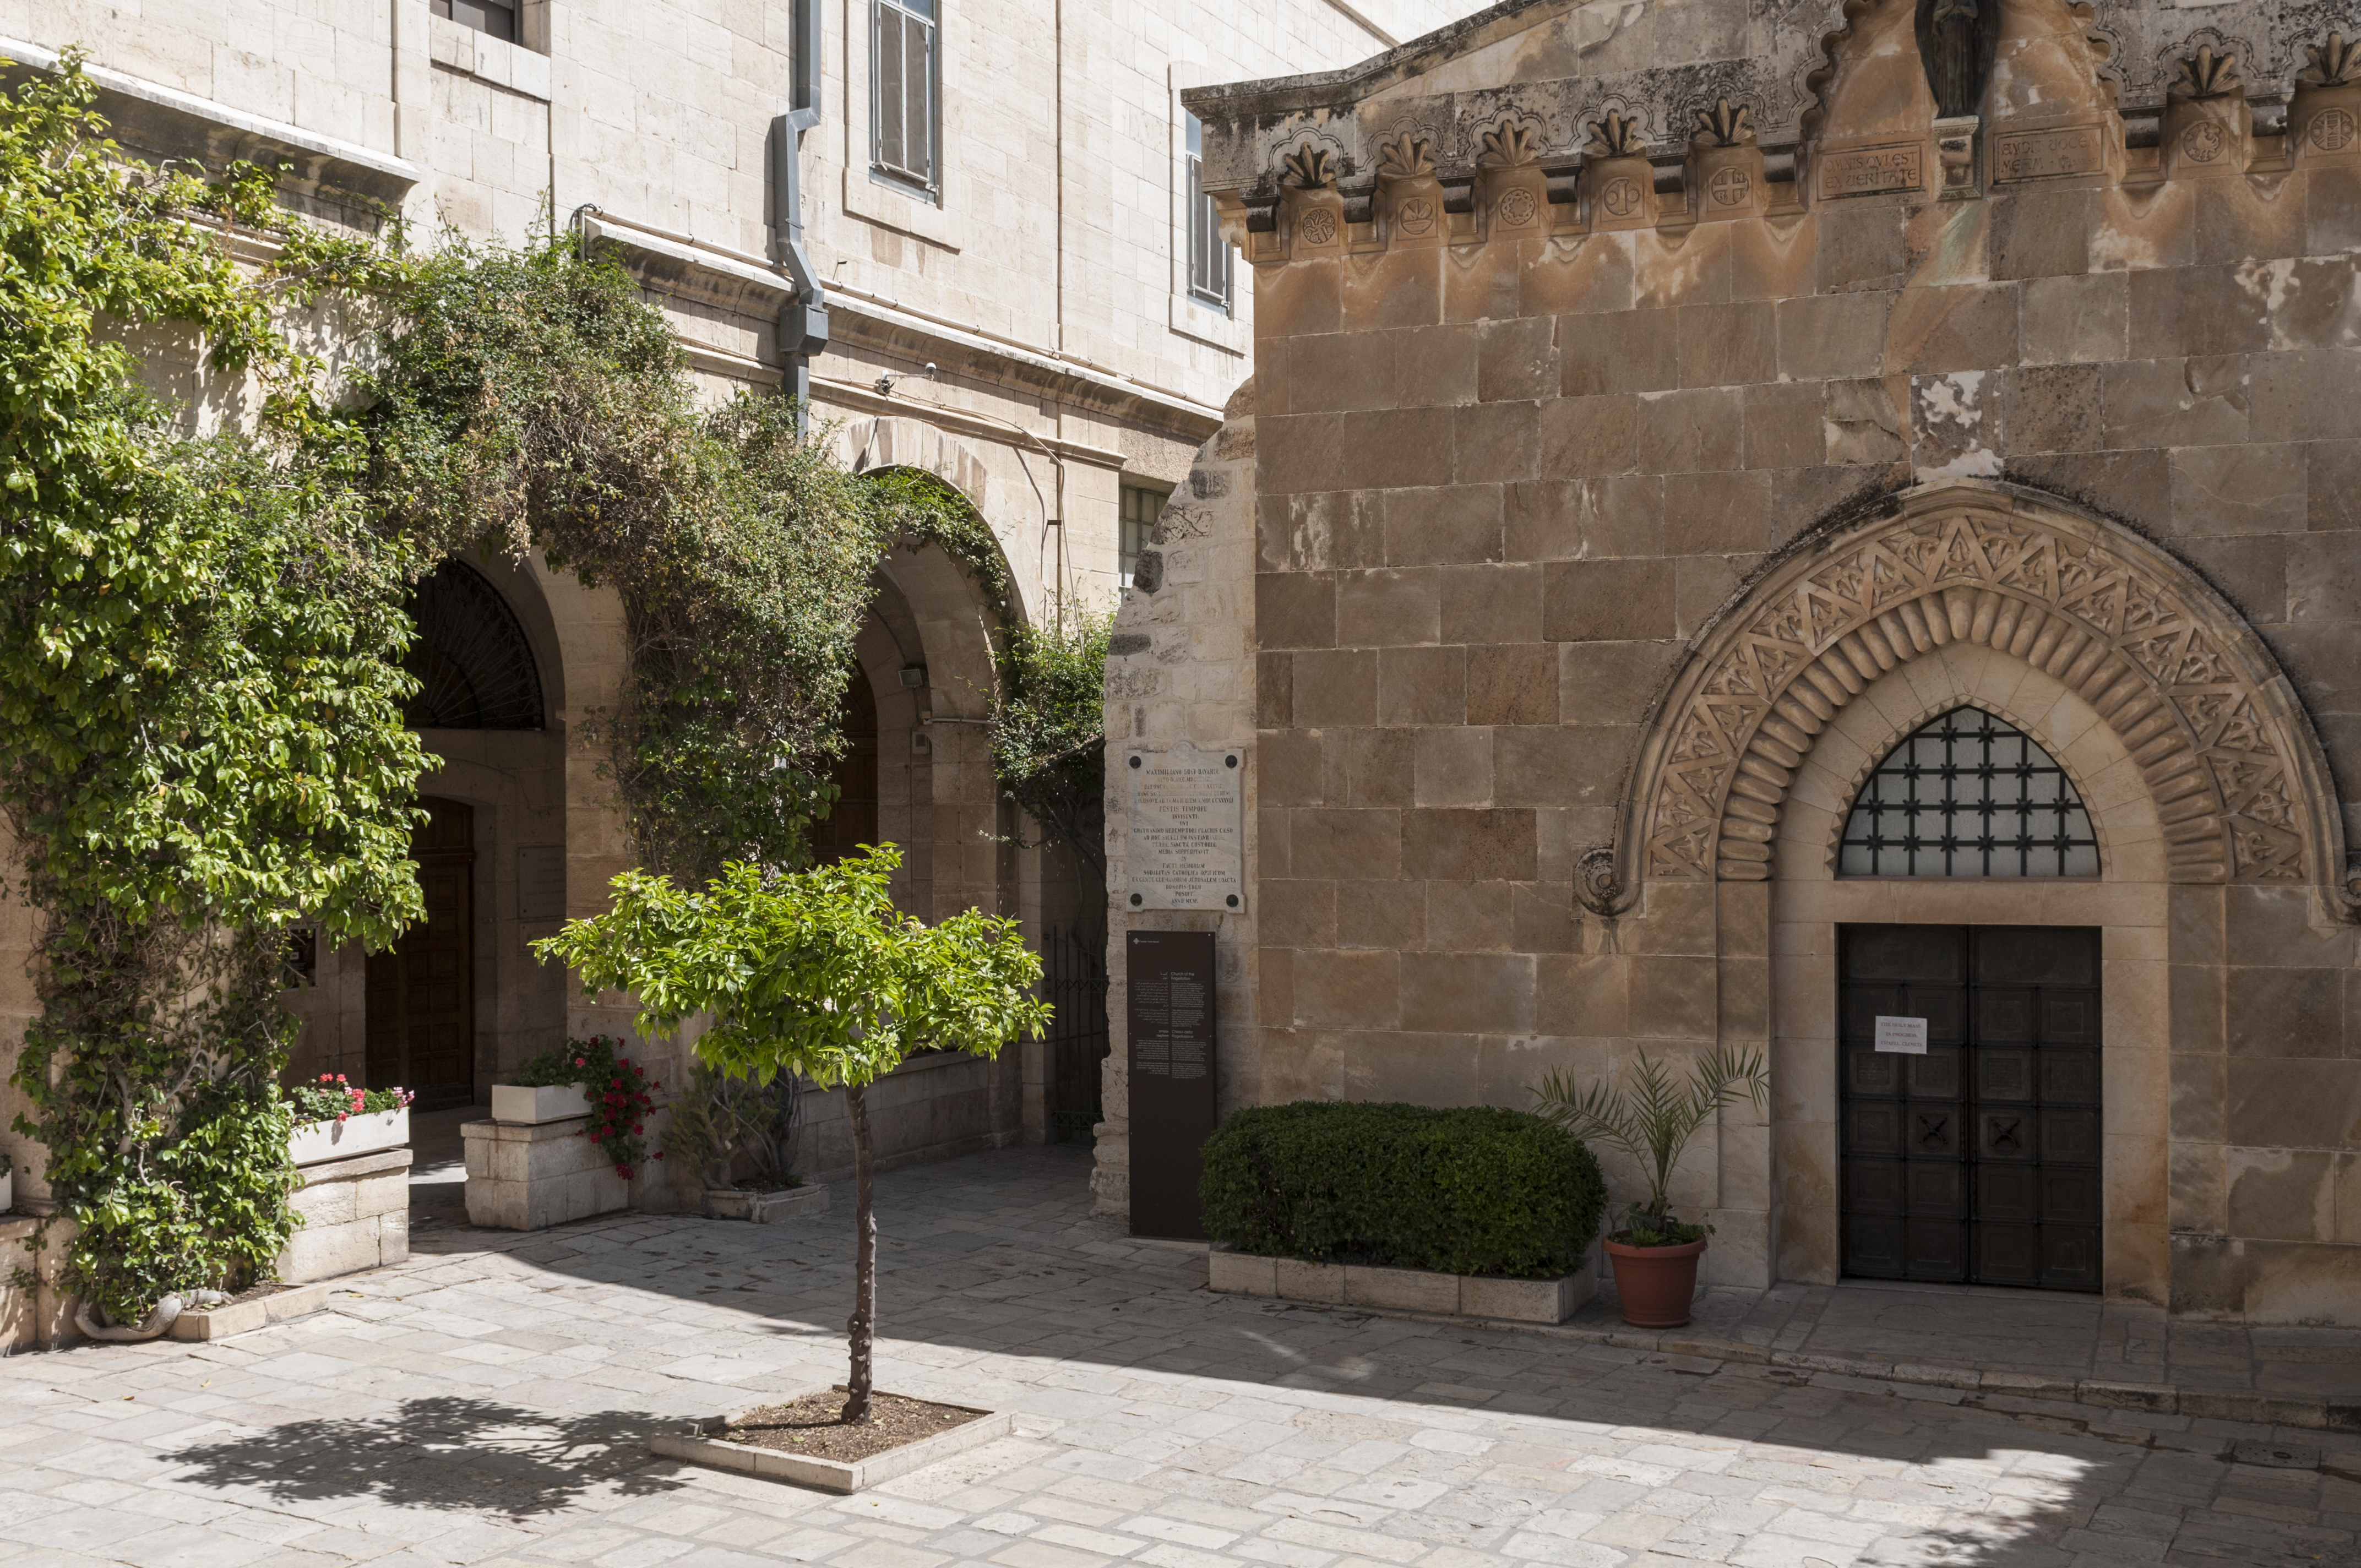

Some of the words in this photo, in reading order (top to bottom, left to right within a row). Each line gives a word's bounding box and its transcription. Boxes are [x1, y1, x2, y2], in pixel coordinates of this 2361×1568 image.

[1825, 157, 1863, 172] OMNIS
[1892, 151, 1918, 166] EST
[1825, 176, 1842, 189] EX
